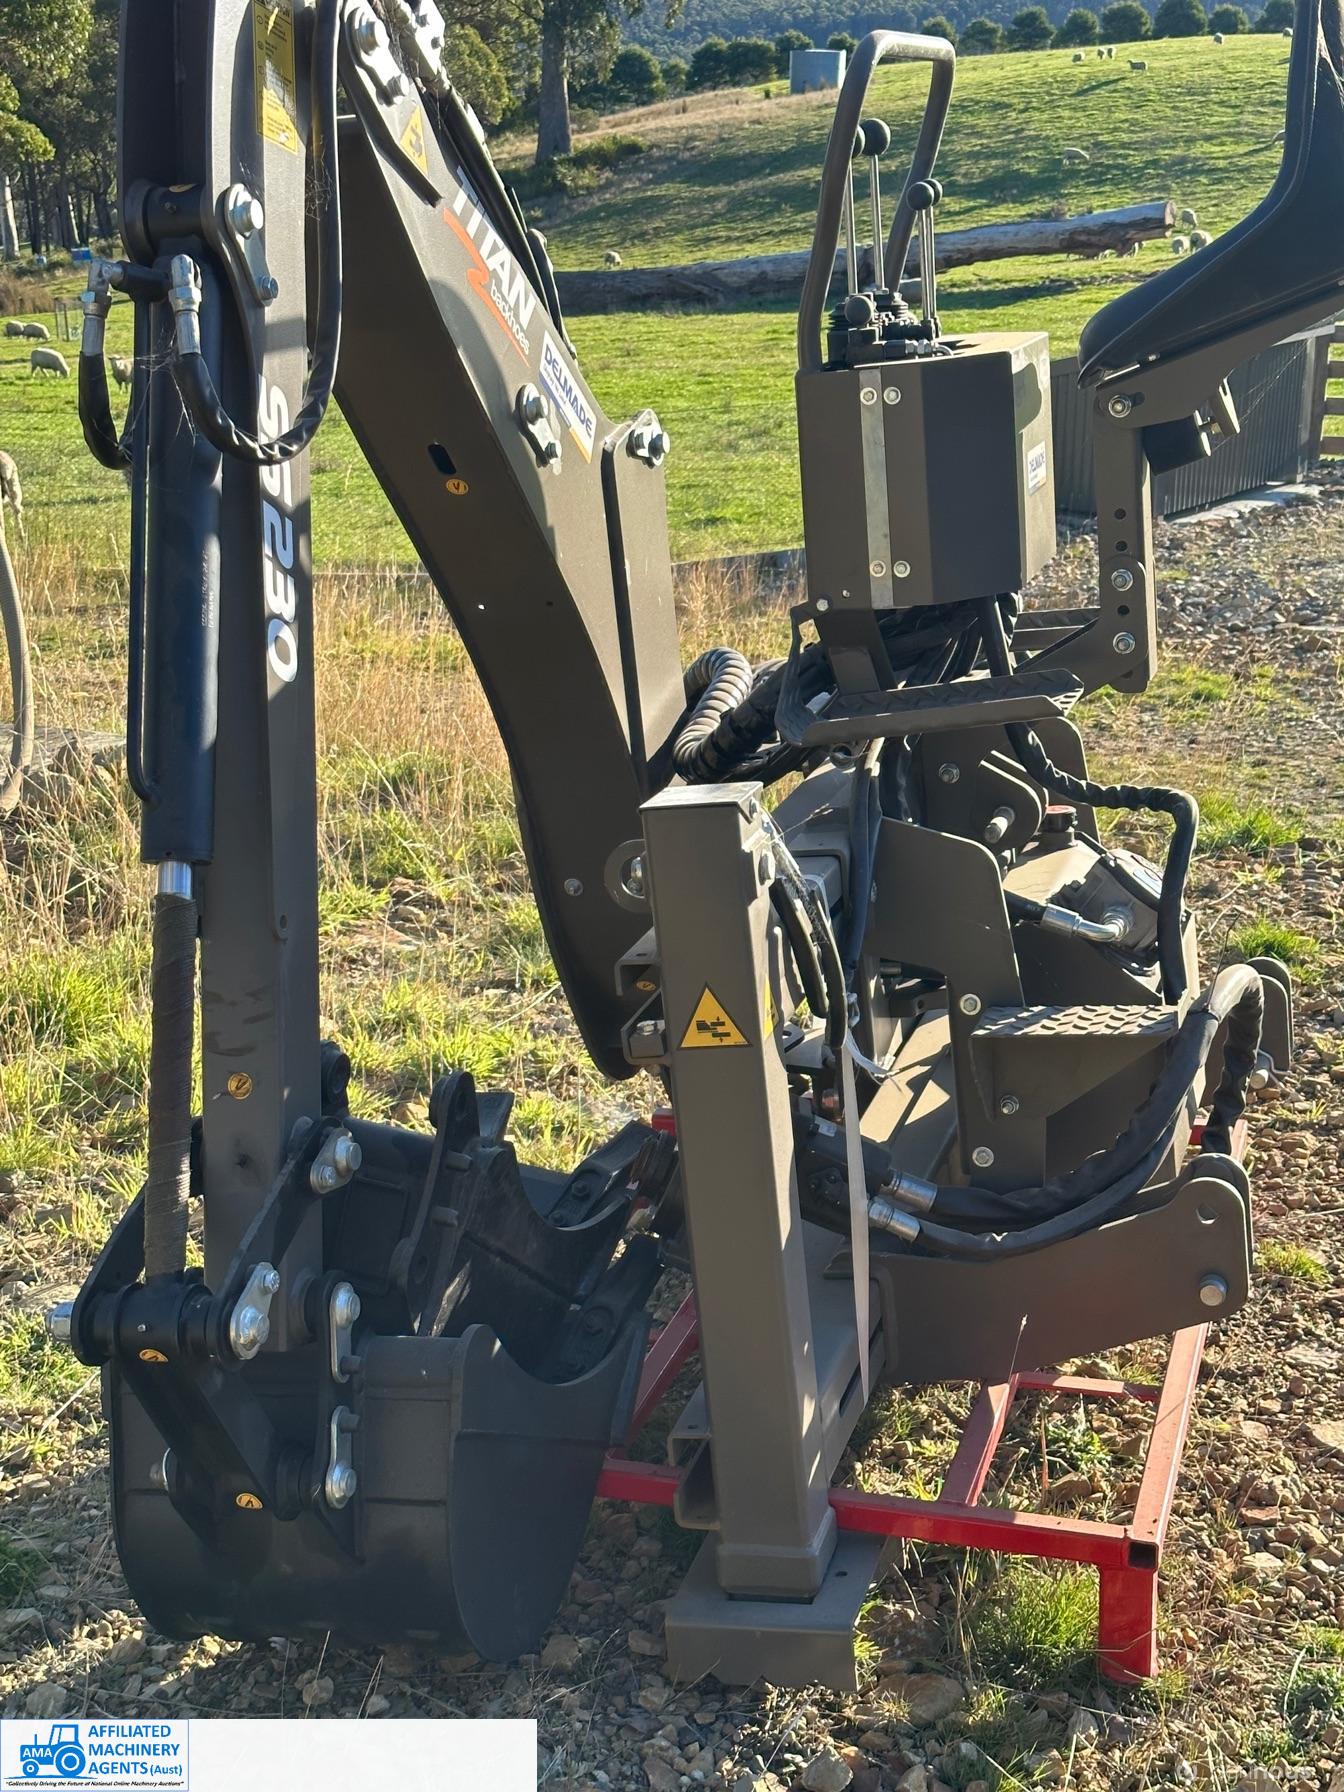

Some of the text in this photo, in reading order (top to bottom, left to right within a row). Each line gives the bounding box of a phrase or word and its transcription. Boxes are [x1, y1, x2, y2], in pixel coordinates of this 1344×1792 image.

[453, 165, 537, 330] TITAN
[490, 279, 529, 355] backhoes
[545, 344, 592, 438] DELMADE
